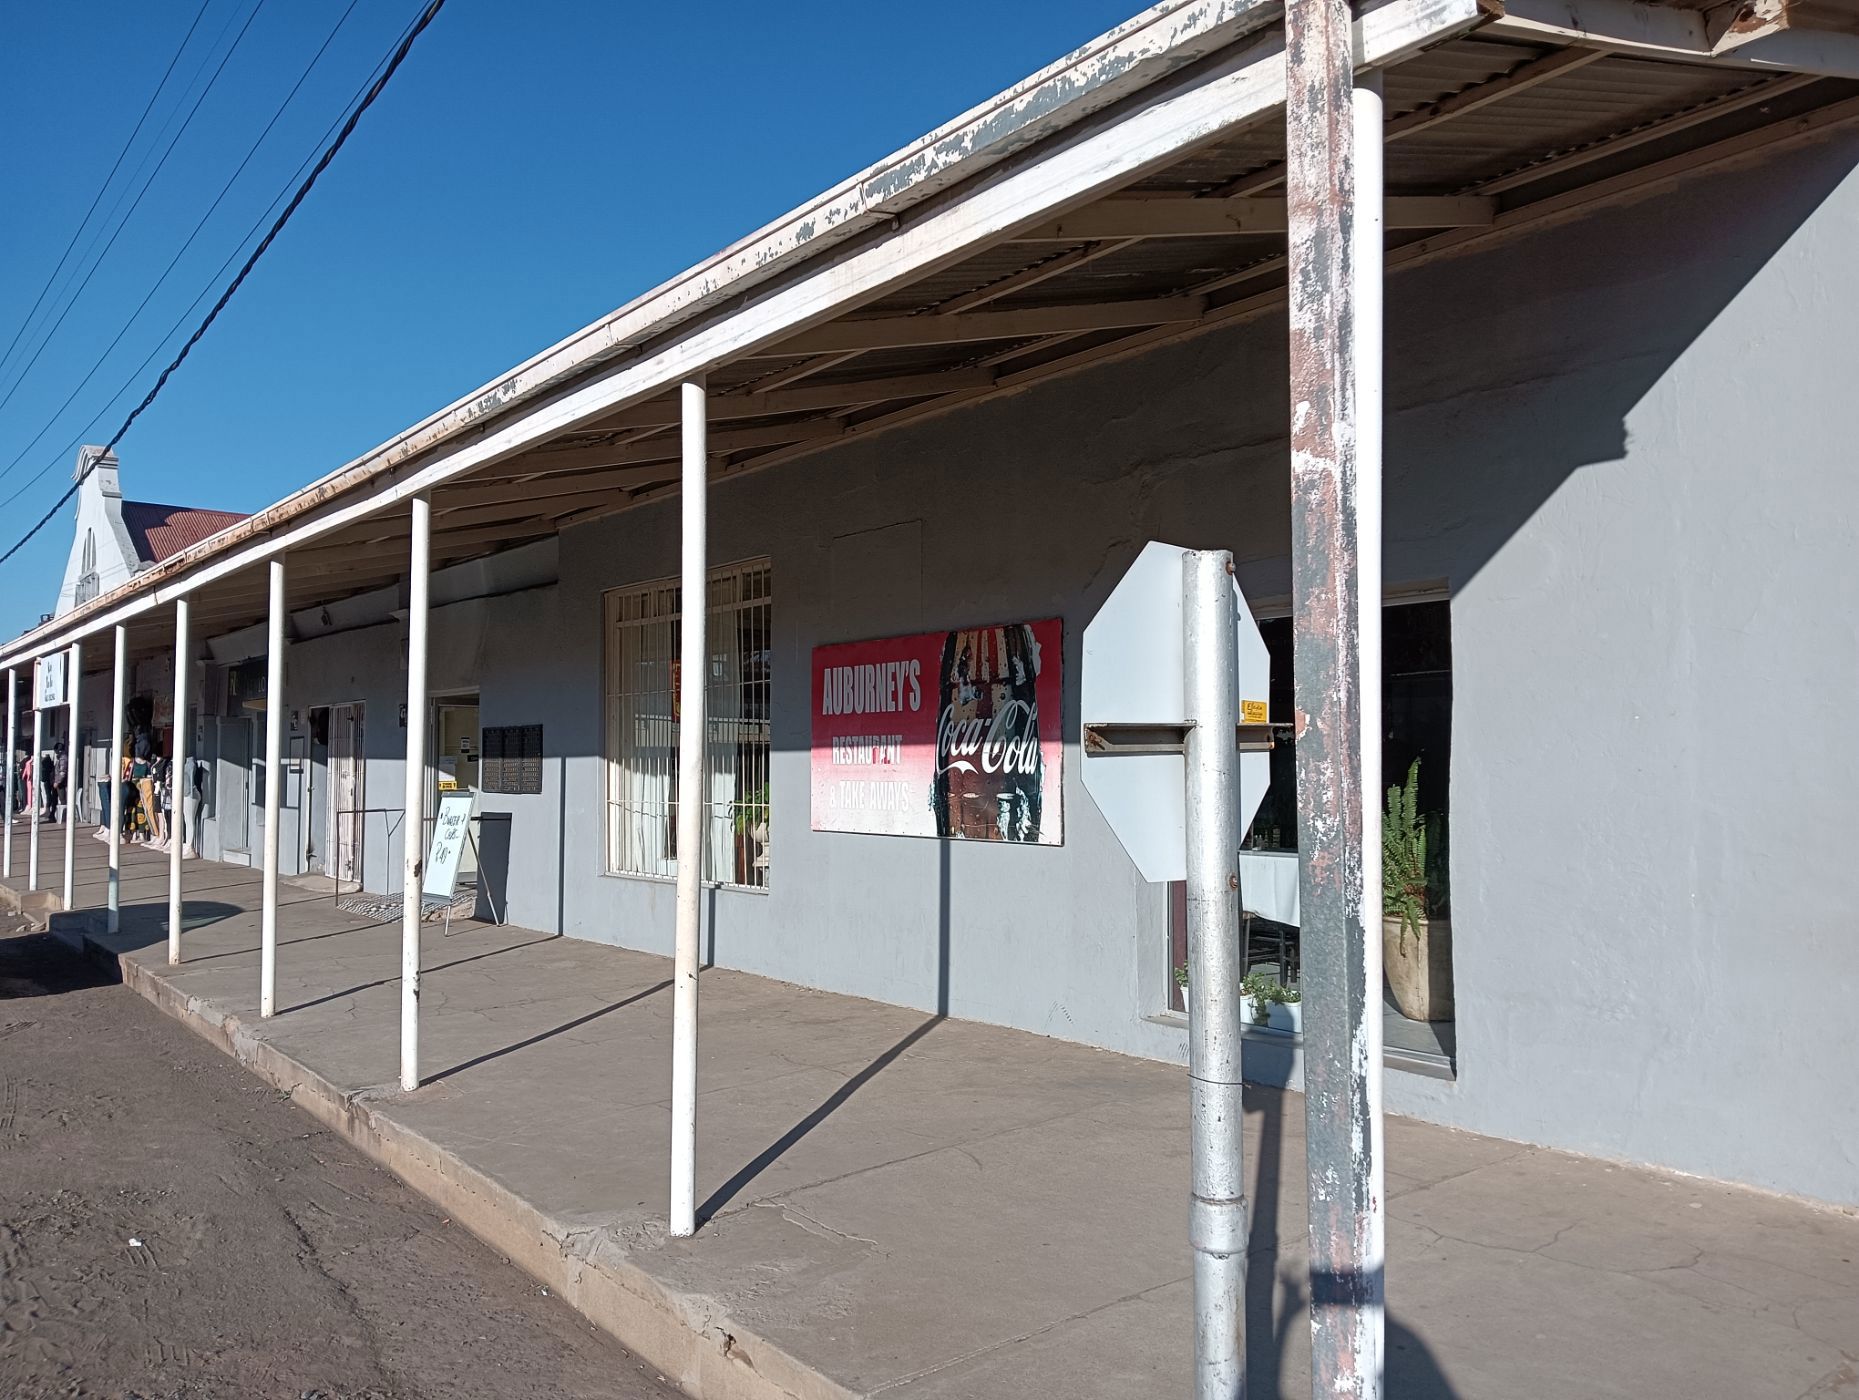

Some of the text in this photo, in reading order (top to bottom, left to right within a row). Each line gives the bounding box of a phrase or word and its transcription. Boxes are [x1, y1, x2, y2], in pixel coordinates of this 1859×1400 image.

[822, 659, 921, 715] AUBURNEY'S
[936, 699, 1038, 775] Coca-Cola
[839, 780, 865, 809] TAKE
[869, 781, 909, 811] AWAYS
